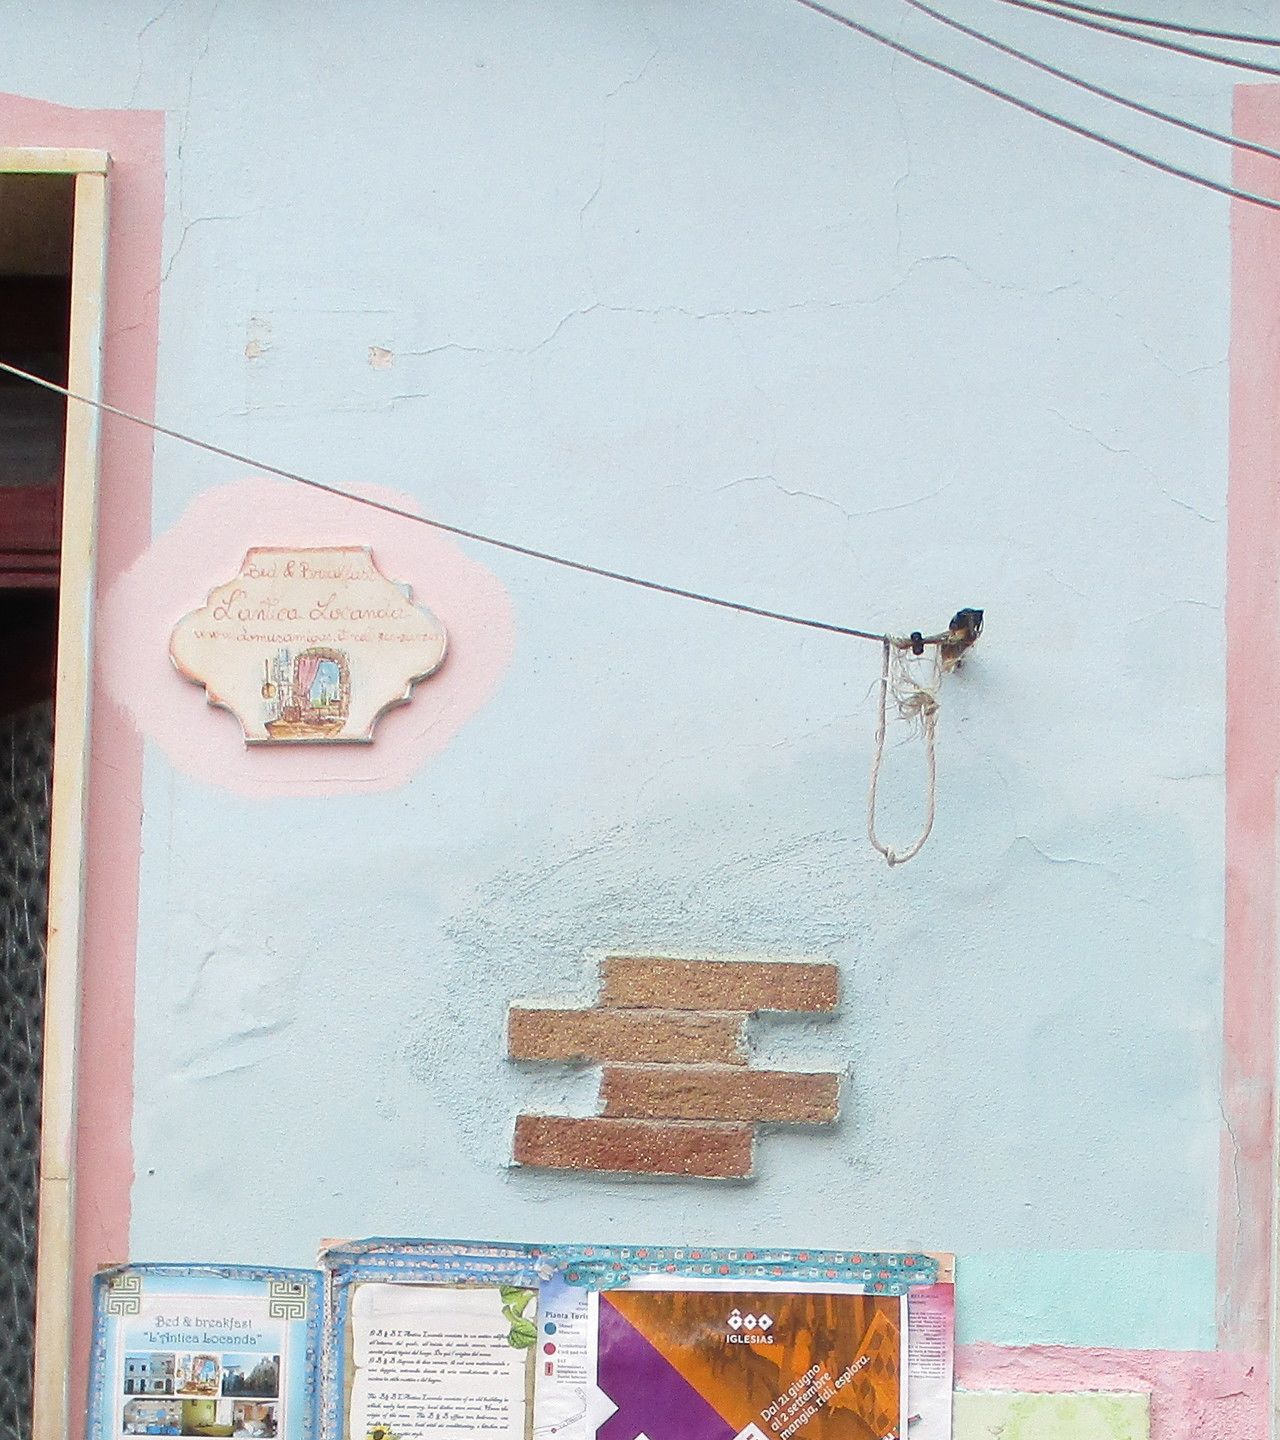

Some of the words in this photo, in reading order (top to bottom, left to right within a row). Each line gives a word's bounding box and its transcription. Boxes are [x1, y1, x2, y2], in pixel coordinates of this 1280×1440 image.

[155, 1315, 179, 1327] Bed
[183, 1316, 191, 1327] &
[195, 1317, 252, 1330] breakfast
[726, 1334, 773, 1344] IGLESIAS
[760, 1401, 780, 1422] Dal
[778, 1393, 790, 1405] 21
[788, 1364, 820, 1398] giugno
[771, 1418, 783, 1432] al
[780, 1412, 789, 1423] 2
[787, 1372, 831, 1415] settembre
[816, 1387, 838, 1406] ridi,
[835, 1355, 871, 1389] esplora.
